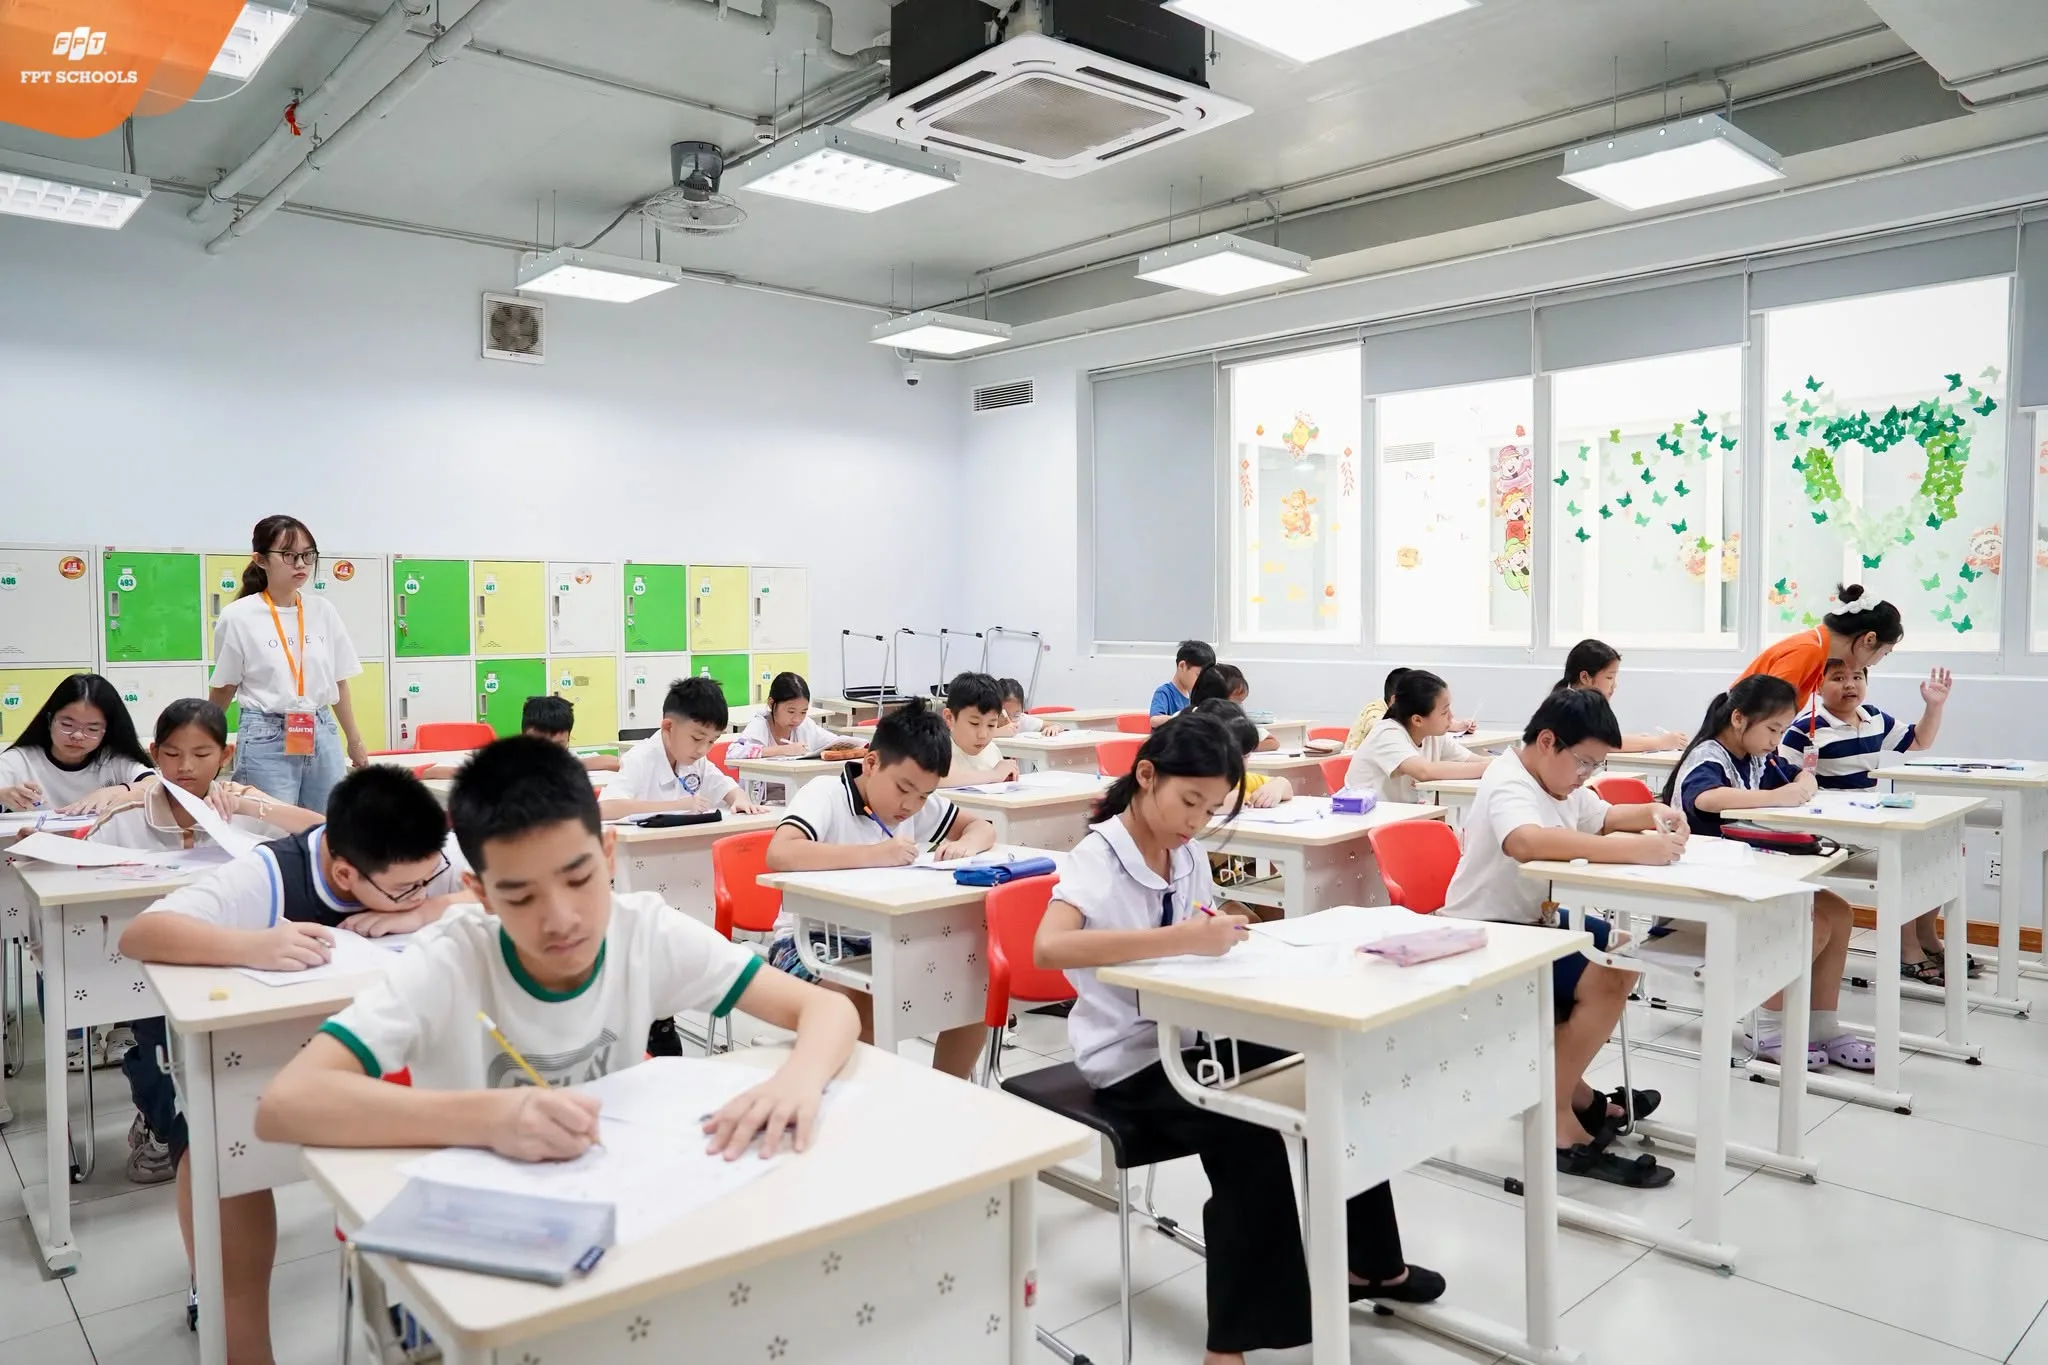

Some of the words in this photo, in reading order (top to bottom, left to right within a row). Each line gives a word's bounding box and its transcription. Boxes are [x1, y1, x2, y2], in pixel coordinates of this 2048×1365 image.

[1, 577, 16, 585] 496
[120, 578, 133, 586] 493
[269, 635, 326, 649] OBEY
[4, 697, 19, 705] 497
[124, 694, 138, 702] 494
